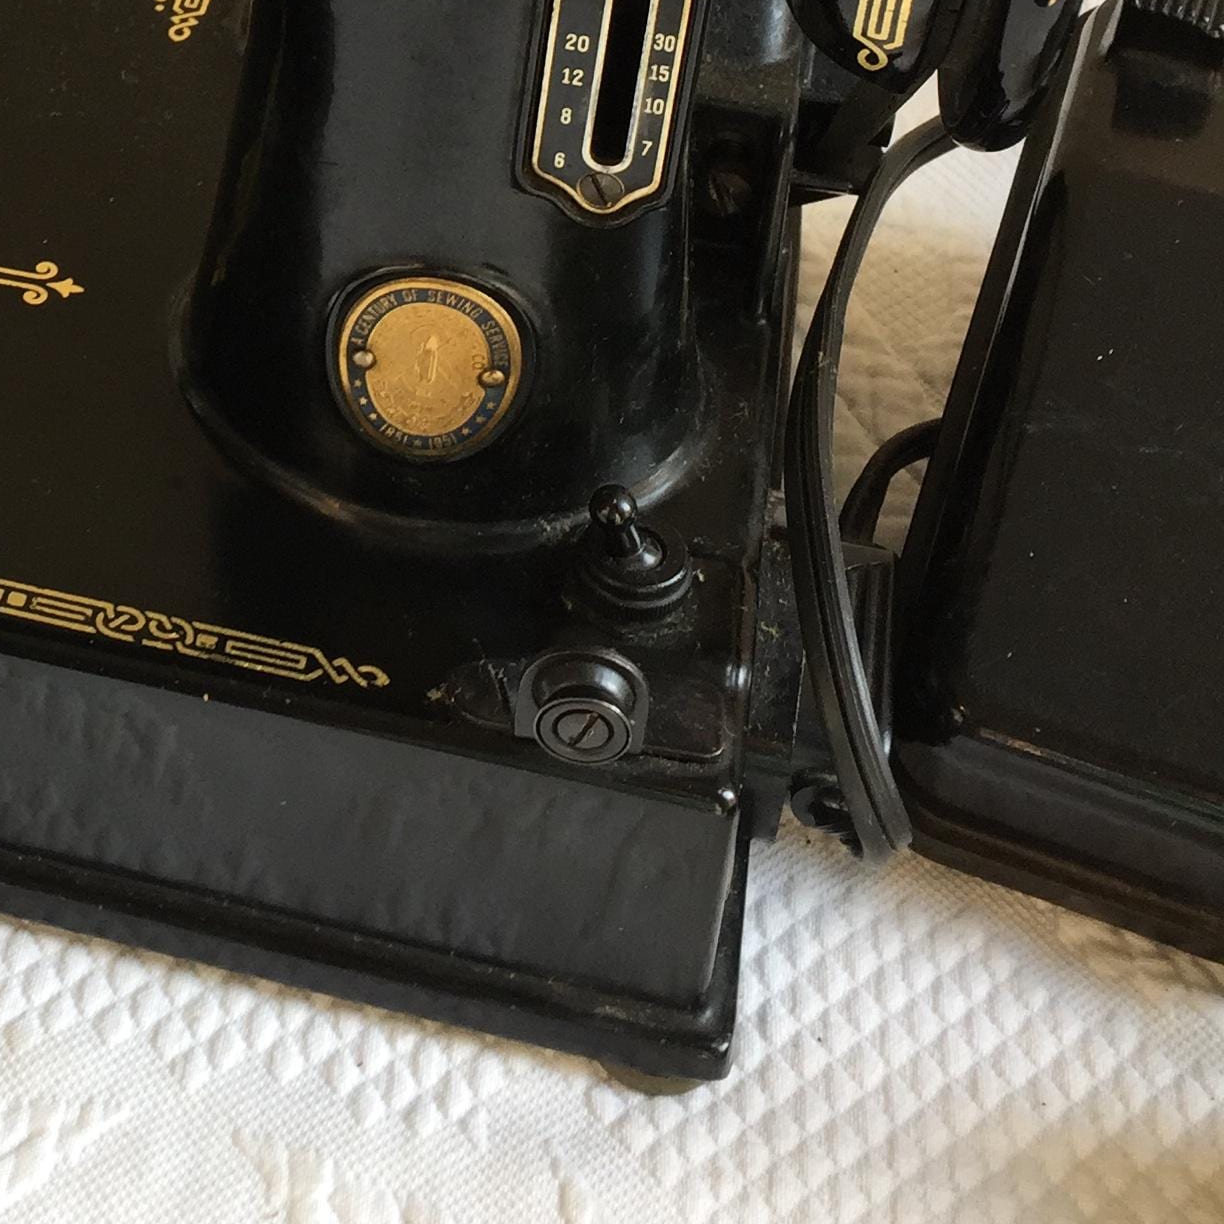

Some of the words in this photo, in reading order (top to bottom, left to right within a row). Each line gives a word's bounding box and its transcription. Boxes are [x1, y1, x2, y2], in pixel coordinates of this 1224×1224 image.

[564, 33, 591, 53] 20
[653, 33, 676, 53] 30
[561, 68, 585, 87] 12
[648, 64, 670, 82] 15
[644, 97, 664, 115] 10
[560, 107, 572, 125] 8
[641, 140, 653, 157] 7
[553, 152, 566, 168] 6
[402, 289, 419, 302] OF
[427, 290, 482, 319] SEWING
[355, 293, 398, 335] CENTURY
[351, 335, 365, 346] A
[481, 320, 509, 368] SERVICE
[378, 424, 409, 445] 1851
[428, 434, 457, 450] 1951
